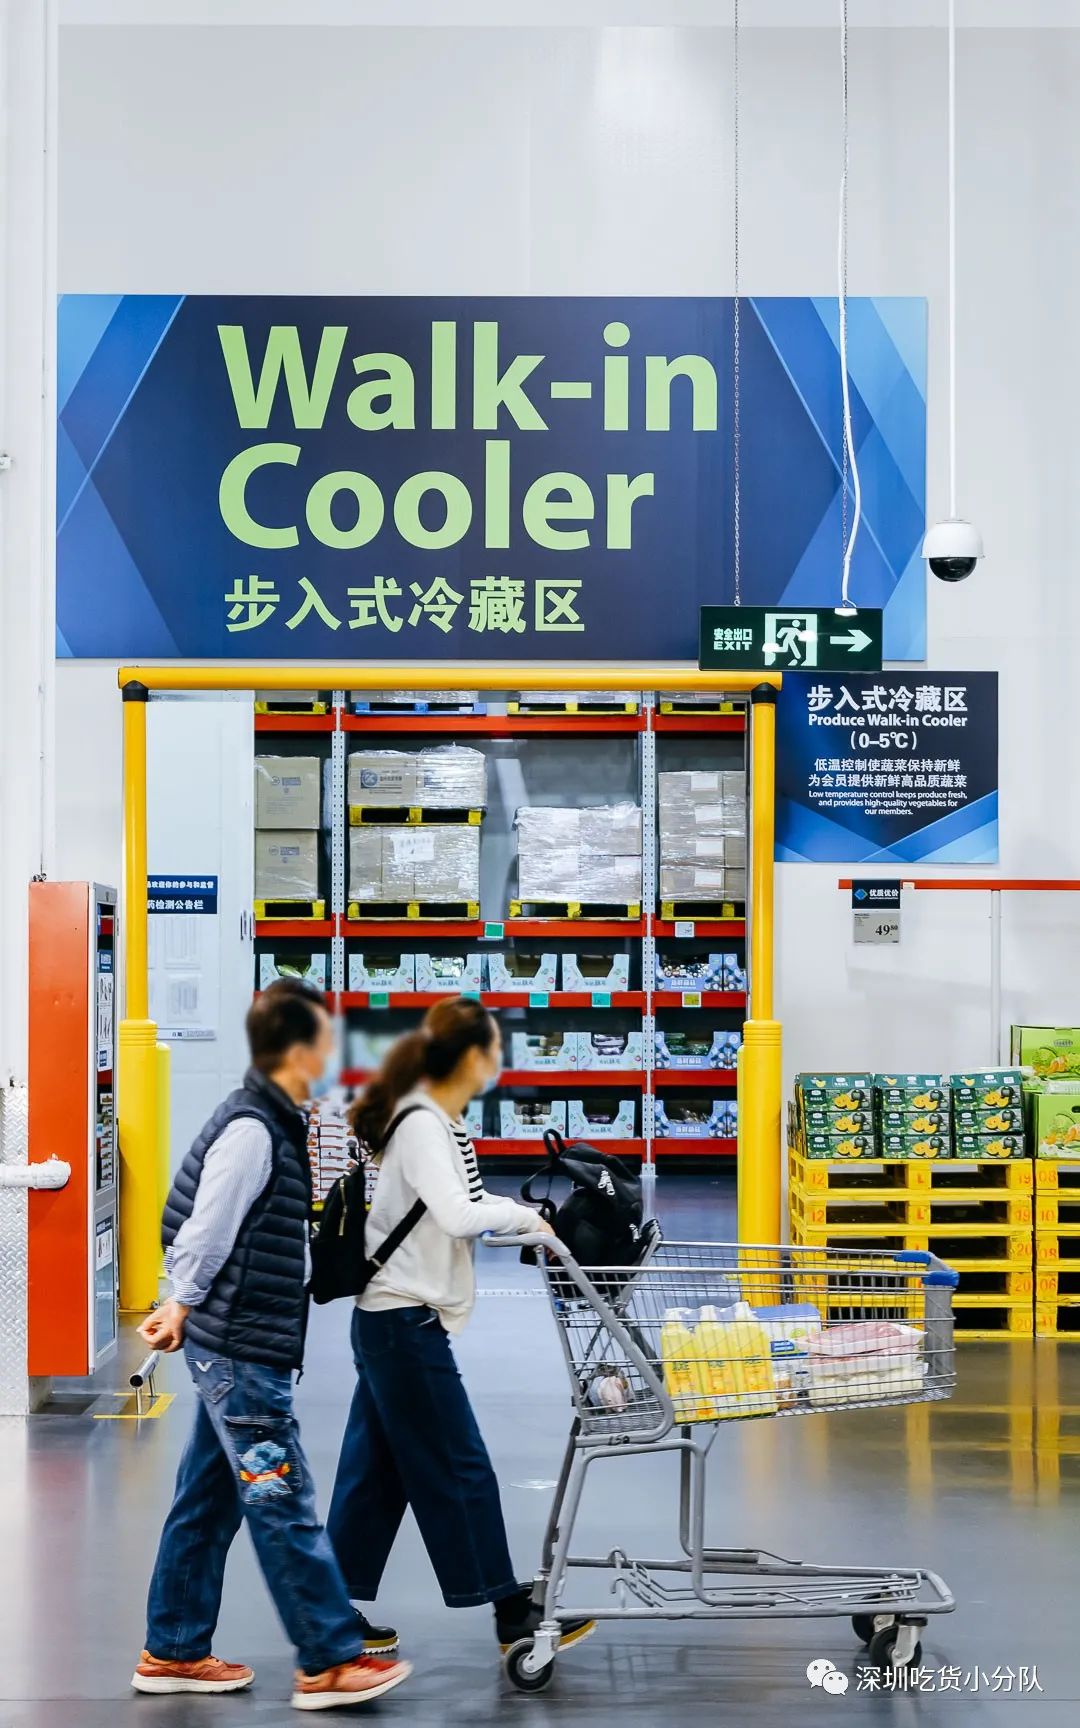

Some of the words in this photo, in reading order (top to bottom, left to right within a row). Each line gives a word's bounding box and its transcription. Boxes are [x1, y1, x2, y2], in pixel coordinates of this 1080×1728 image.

[217, 321, 718, 432] Walk-in
[218, 439, 655, 551] Cooler
[224, 575, 585, 634] 步入式冷藏区
[713, 627, 753, 641] 安全出口
[713, 641, 753, 651] EXIT
[807, 685, 968, 712] 步入式冷藏区
[808, 713, 866, 727] Produce
[867, 713, 920, 727] Walk-in
[922, 713, 968, 727] Cooler
[814, 758, 961, 772] 低温控制使蔬菜保持新鲜
[808, 774, 967, 788] 为会员提供新鲜高品质蔬菜
[825, 791, 868, 800] temperature
[869, 790, 895, 798] control
[896, 790, 916, 800] keeps
[917, 790, 947, 800] produce
[947, 790, 967, 800] fresh,
[818, 799, 833, 807] and
[834, 799, 864, 808] provides
[865, 799, 907, 809] high-quality
[908, 799, 946, 809] vegetables
[947, 799, 957, 807] for
